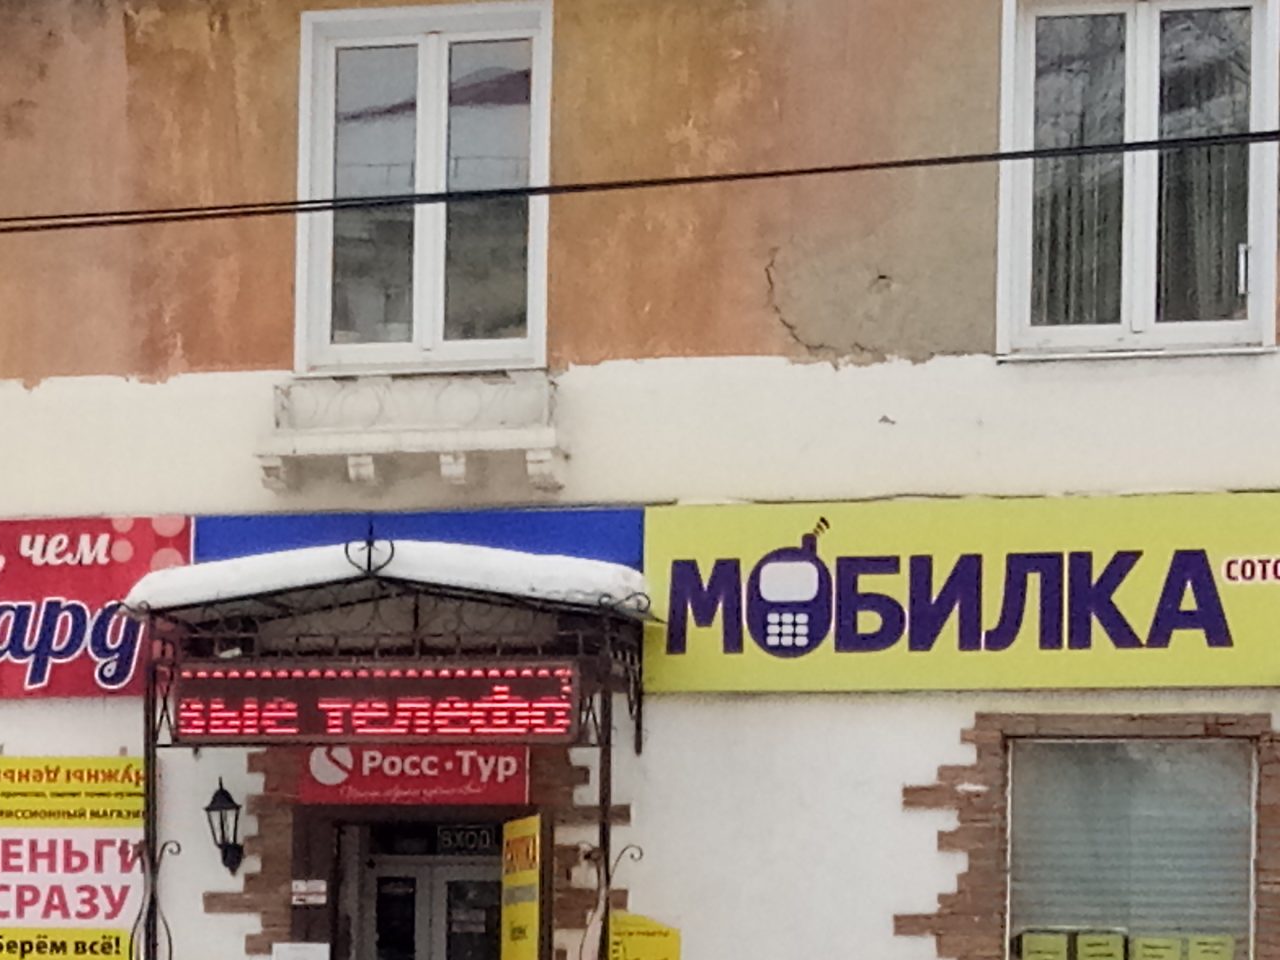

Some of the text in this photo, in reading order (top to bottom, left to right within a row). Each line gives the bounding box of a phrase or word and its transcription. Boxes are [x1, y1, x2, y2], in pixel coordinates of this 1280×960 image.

[19, 532, 111, 566] чем
[665, 543, 1235, 659] МОБИЛКА
[89, 807, 145, 819] МАГАЗИ
[73, 934, 121, 956] всё!
